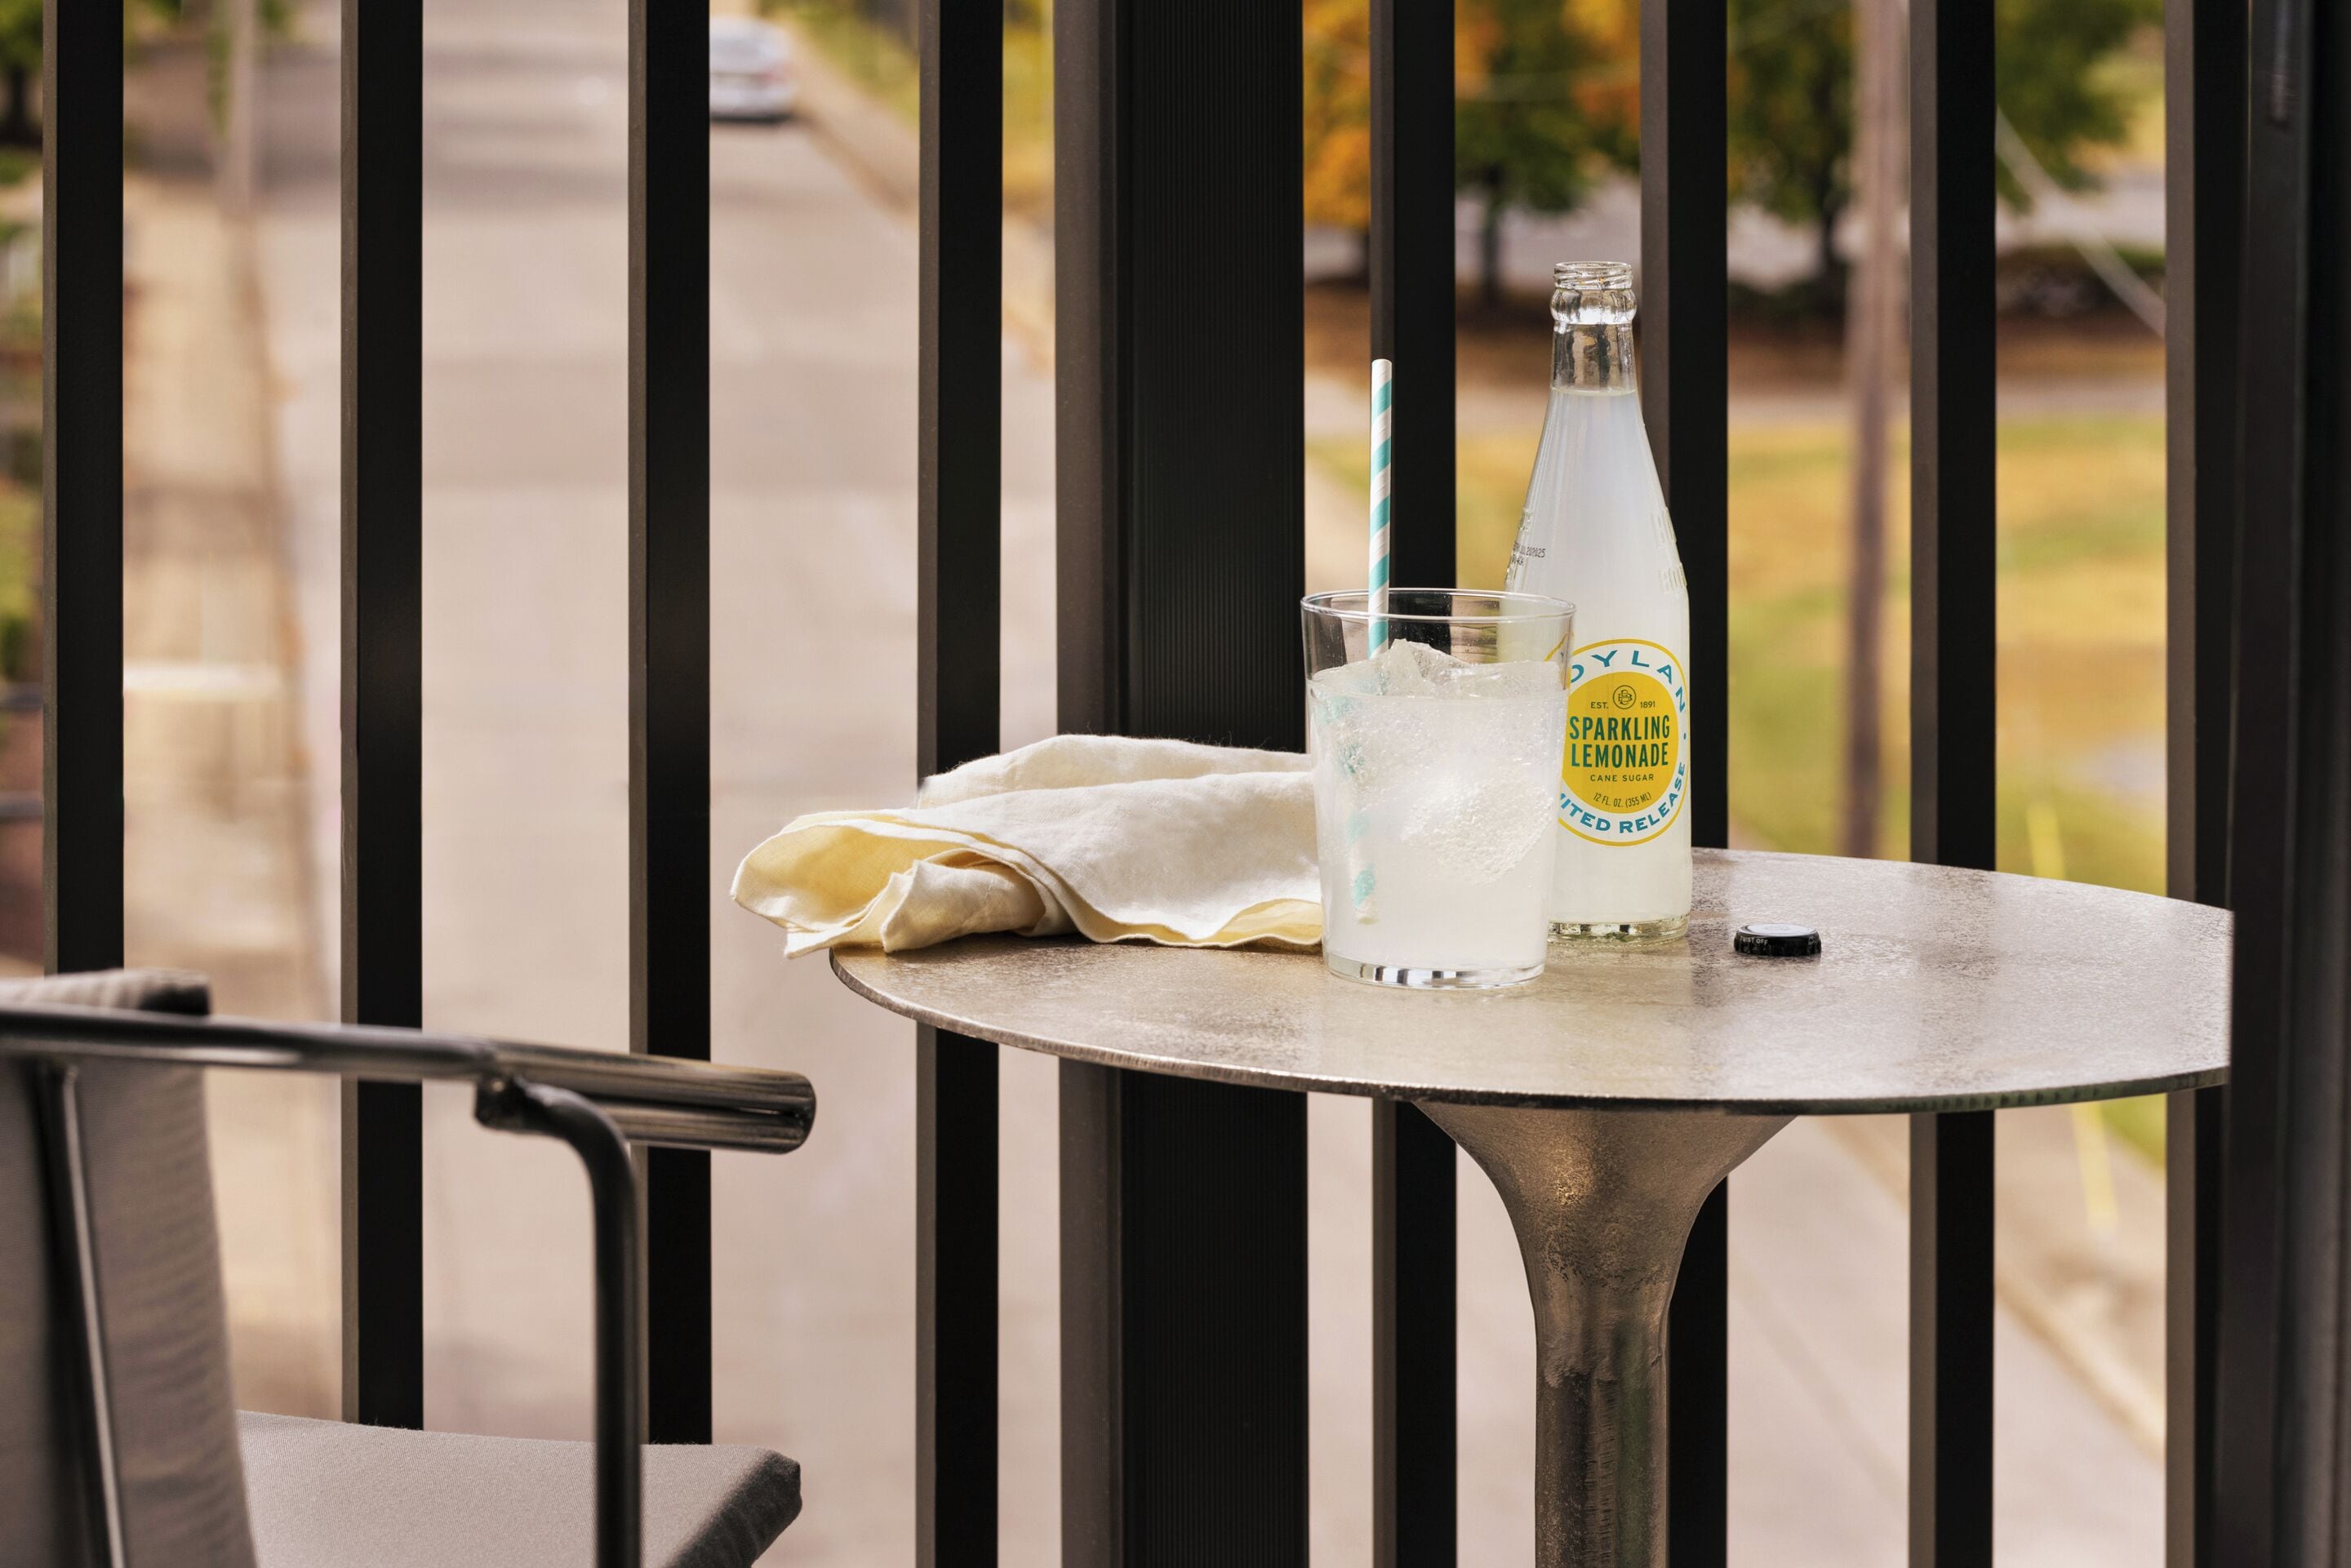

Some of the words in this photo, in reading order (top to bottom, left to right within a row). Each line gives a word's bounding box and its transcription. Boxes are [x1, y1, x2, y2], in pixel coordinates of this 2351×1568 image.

[1570, 650, 1687, 713] OYLAN
[1589, 701, 1609, 710] EST.
[1640, 700, 1655, 709] 1891
[1569, 714, 1670, 741] SPARKLING
[1571, 742, 1669, 769] LEMONADE
[1590, 774, 1617, 782] CANE
[1622, 773, 1654, 782] SUGAR
[1560, 793, 1611, 832] ITED
[1619, 762, 1687, 834] RELEASE
[1593, 792, 1602, 802] 12
[1602, 795, 1611, 806] FL.
[1613, 798, 1624, 807] OZ.
[1625, 796, 1640, 808] (355
[1640, 791, 1651, 803] ML)
